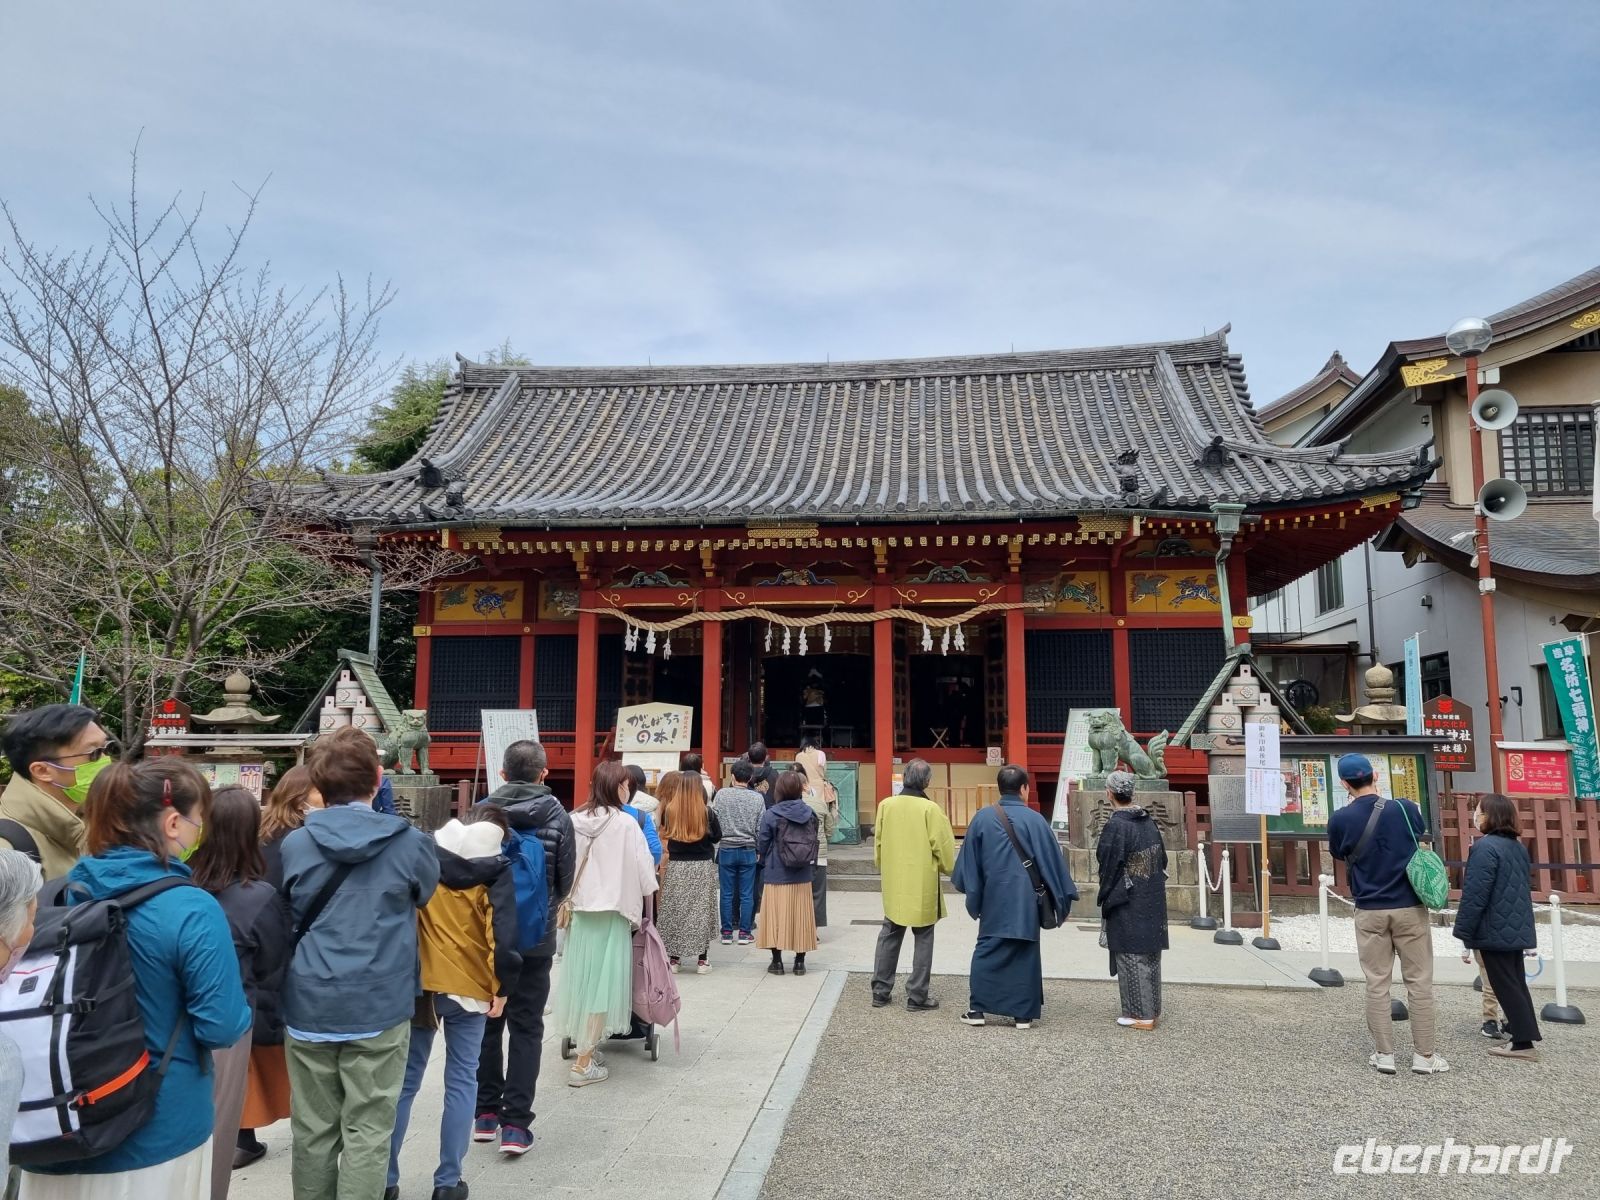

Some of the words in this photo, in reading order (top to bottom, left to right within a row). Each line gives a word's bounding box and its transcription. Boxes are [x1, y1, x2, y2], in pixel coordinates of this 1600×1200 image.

[626, 712, 679, 729] がんばろう
